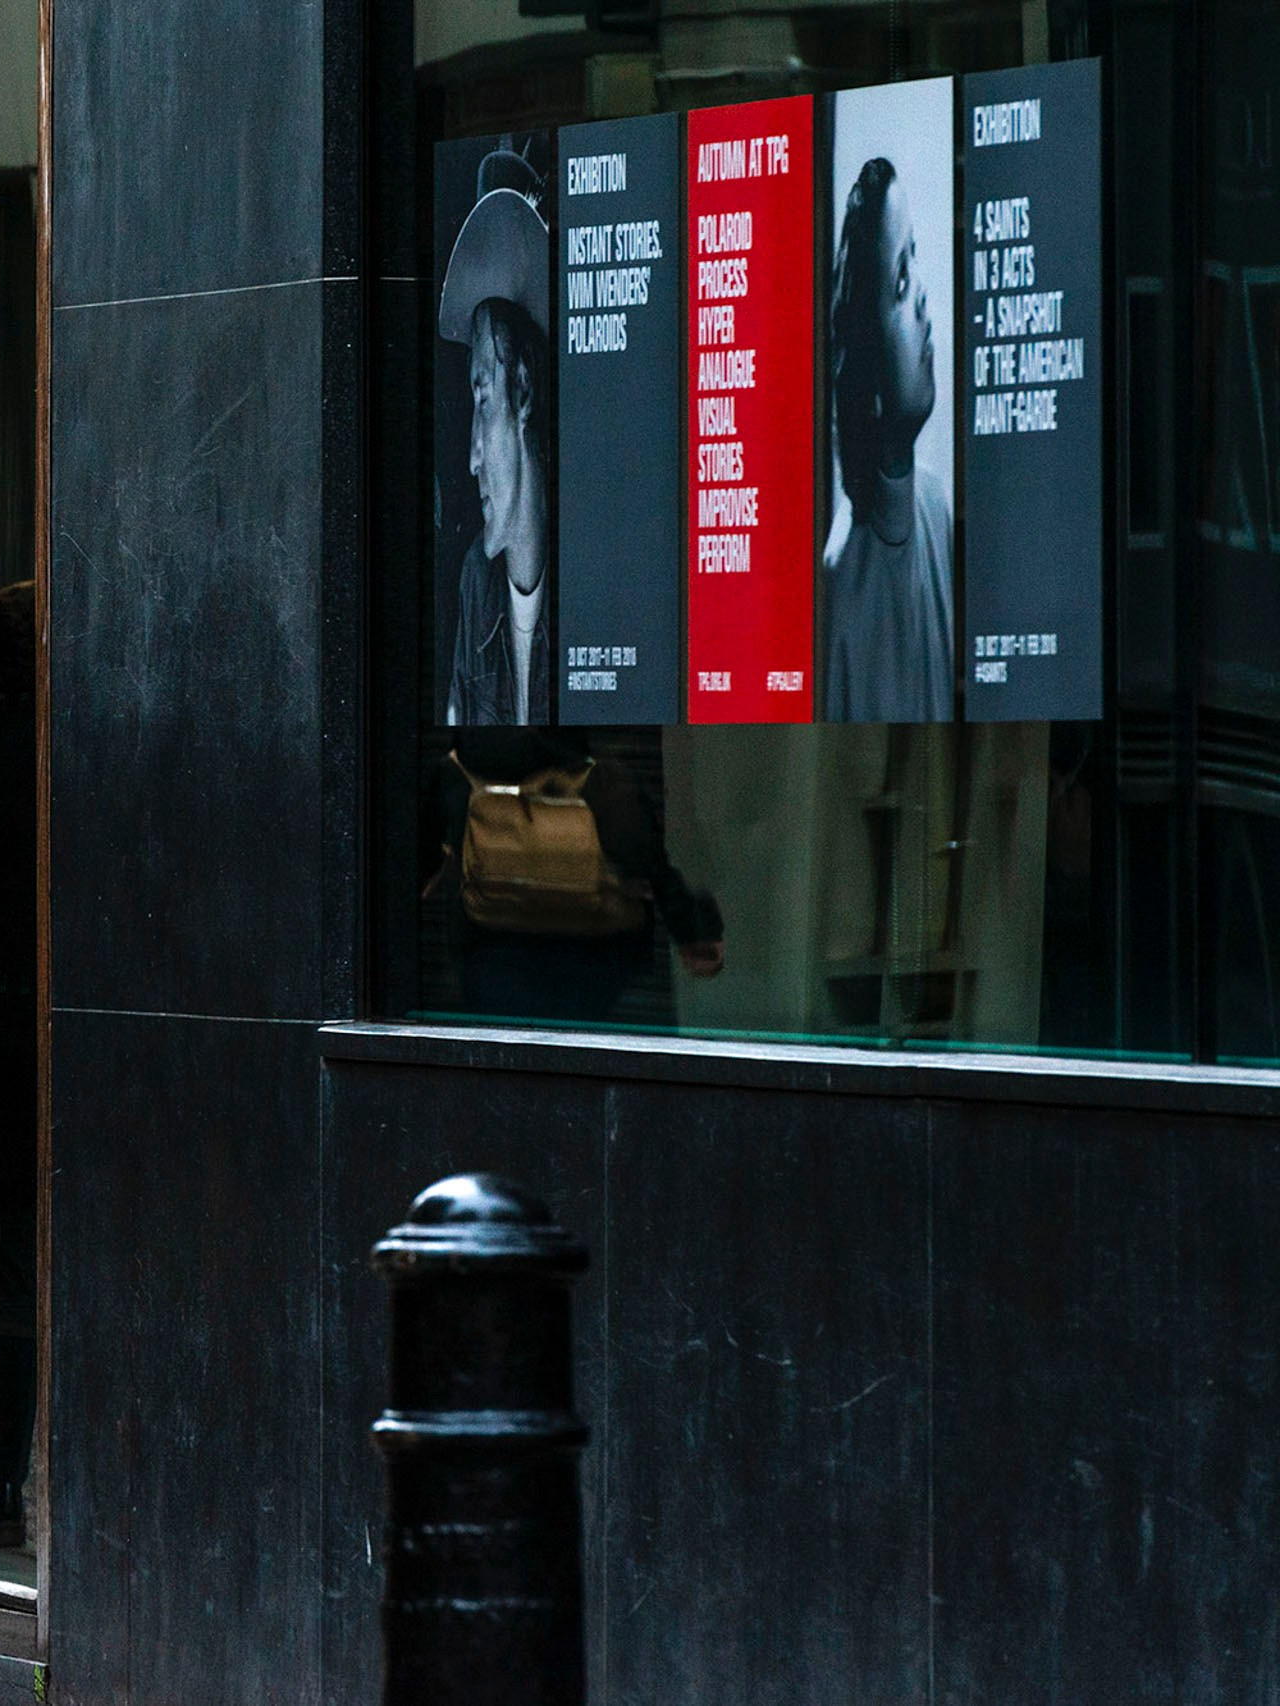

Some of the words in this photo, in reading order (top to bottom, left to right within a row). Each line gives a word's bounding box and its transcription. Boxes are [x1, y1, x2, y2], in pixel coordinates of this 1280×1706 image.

[974, 98, 1041, 147] EXHIBITION
[567, 153, 627, 195] EXHIBITION
[697, 140, 746, 183] AUTUMN
[748, 137, 763, 178] AT
[766, 135, 789, 176] TPG
[698, 211, 753, 254] POLAROID
[973, 202, 983, 243] 4
[985, 196, 1030, 242] SAINTS
[567, 224, 613, 265] INSTANT
[615, 220, 662, 262] STORIES.
[567, 270, 594, 309] WIM
[596, 266, 651, 308] WENDERS'
[698, 257, 748, 300] PROCESS
[973, 250, 988, 291] IN
[990, 248, 999, 290] 3
[1002, 245, 1035, 289] ACTS
[567, 313, 627, 354] POLAROIDS
[698, 305, 735, 346] HYPER
[985, 297, 995, 338] A
[997, 290, 1064, 338] SNAPSHOT
[697, 349, 756, 391] ANALOGUE
[974, 346, 990, 387] OF
[992, 344, 1016, 385] THE
[1018, 338, 1084, 384] AMERICAN
[697, 396, 737, 436] VISUAL
[974, 389, 1058, 435] AVANT-GARDE
[698, 441, 744, 482] STORIES
[698, 487, 759, 528] IMPROVISE
[698, 533, 751, 574] PERFORM
